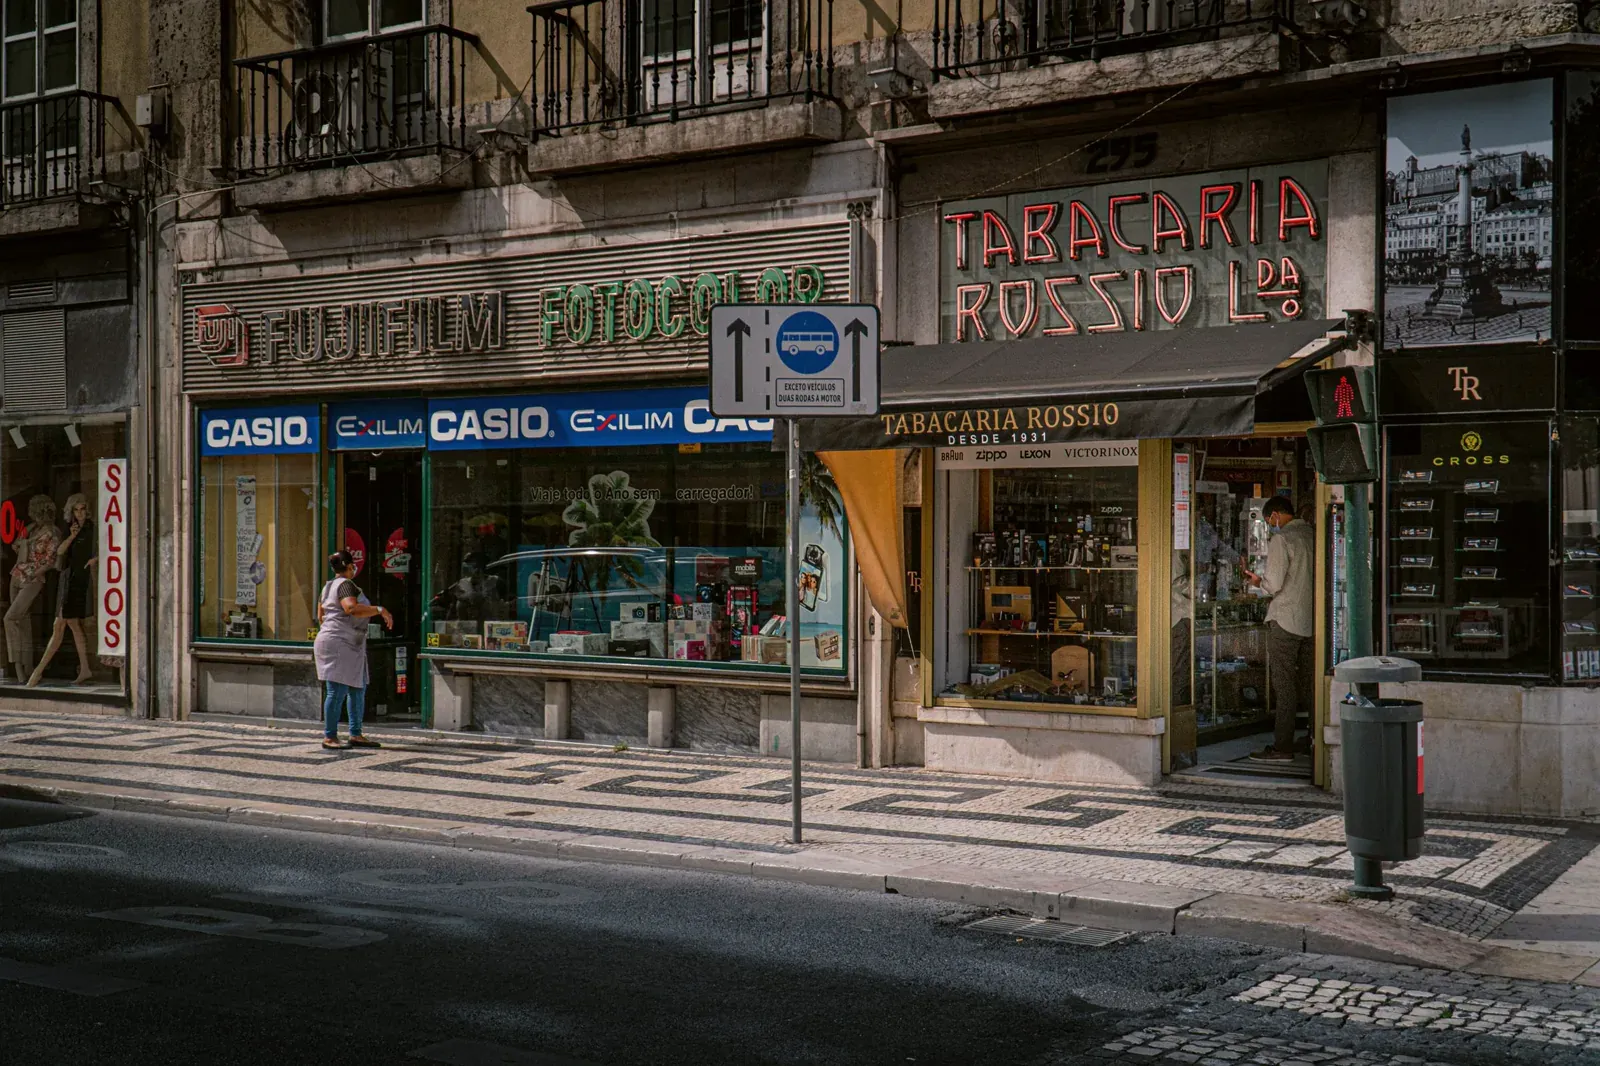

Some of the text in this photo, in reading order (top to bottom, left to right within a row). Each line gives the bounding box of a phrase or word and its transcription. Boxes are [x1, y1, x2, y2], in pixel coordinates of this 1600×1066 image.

[1086, 132, 1159, 174] 295
[944, 177, 1321, 270] TABACARIA
[957, 264, 1193, 342] ROSSIO
[260, 291, 503, 364] FUJIFILM
[784, 381, 836, 391] EXCETO VEÍCULOS
[1448, 367, 1482, 400] TR
[778, 394, 841, 402] DUAS RODAS A MOTOR
[336, 415, 423, 437] EXILIM
[570, 409, 673, 433] EXILIM
[881, 402, 1120, 436] TABACARIA ROSSIO
[948, 432, 1047, 445] DESDE 1931
[1019, 450, 1051, 460] LEXON
[1064, 446, 1138, 458] VICTORINOX
[1433, 455, 1509, 466] CROSS
[531, 487, 560, 502] Viaje
[564, 486, 595, 500] todo
[633, 489, 660, 500] sem
[676, 485, 753, 503] carregador!
[104, 464, 124, 648] SALDOS
